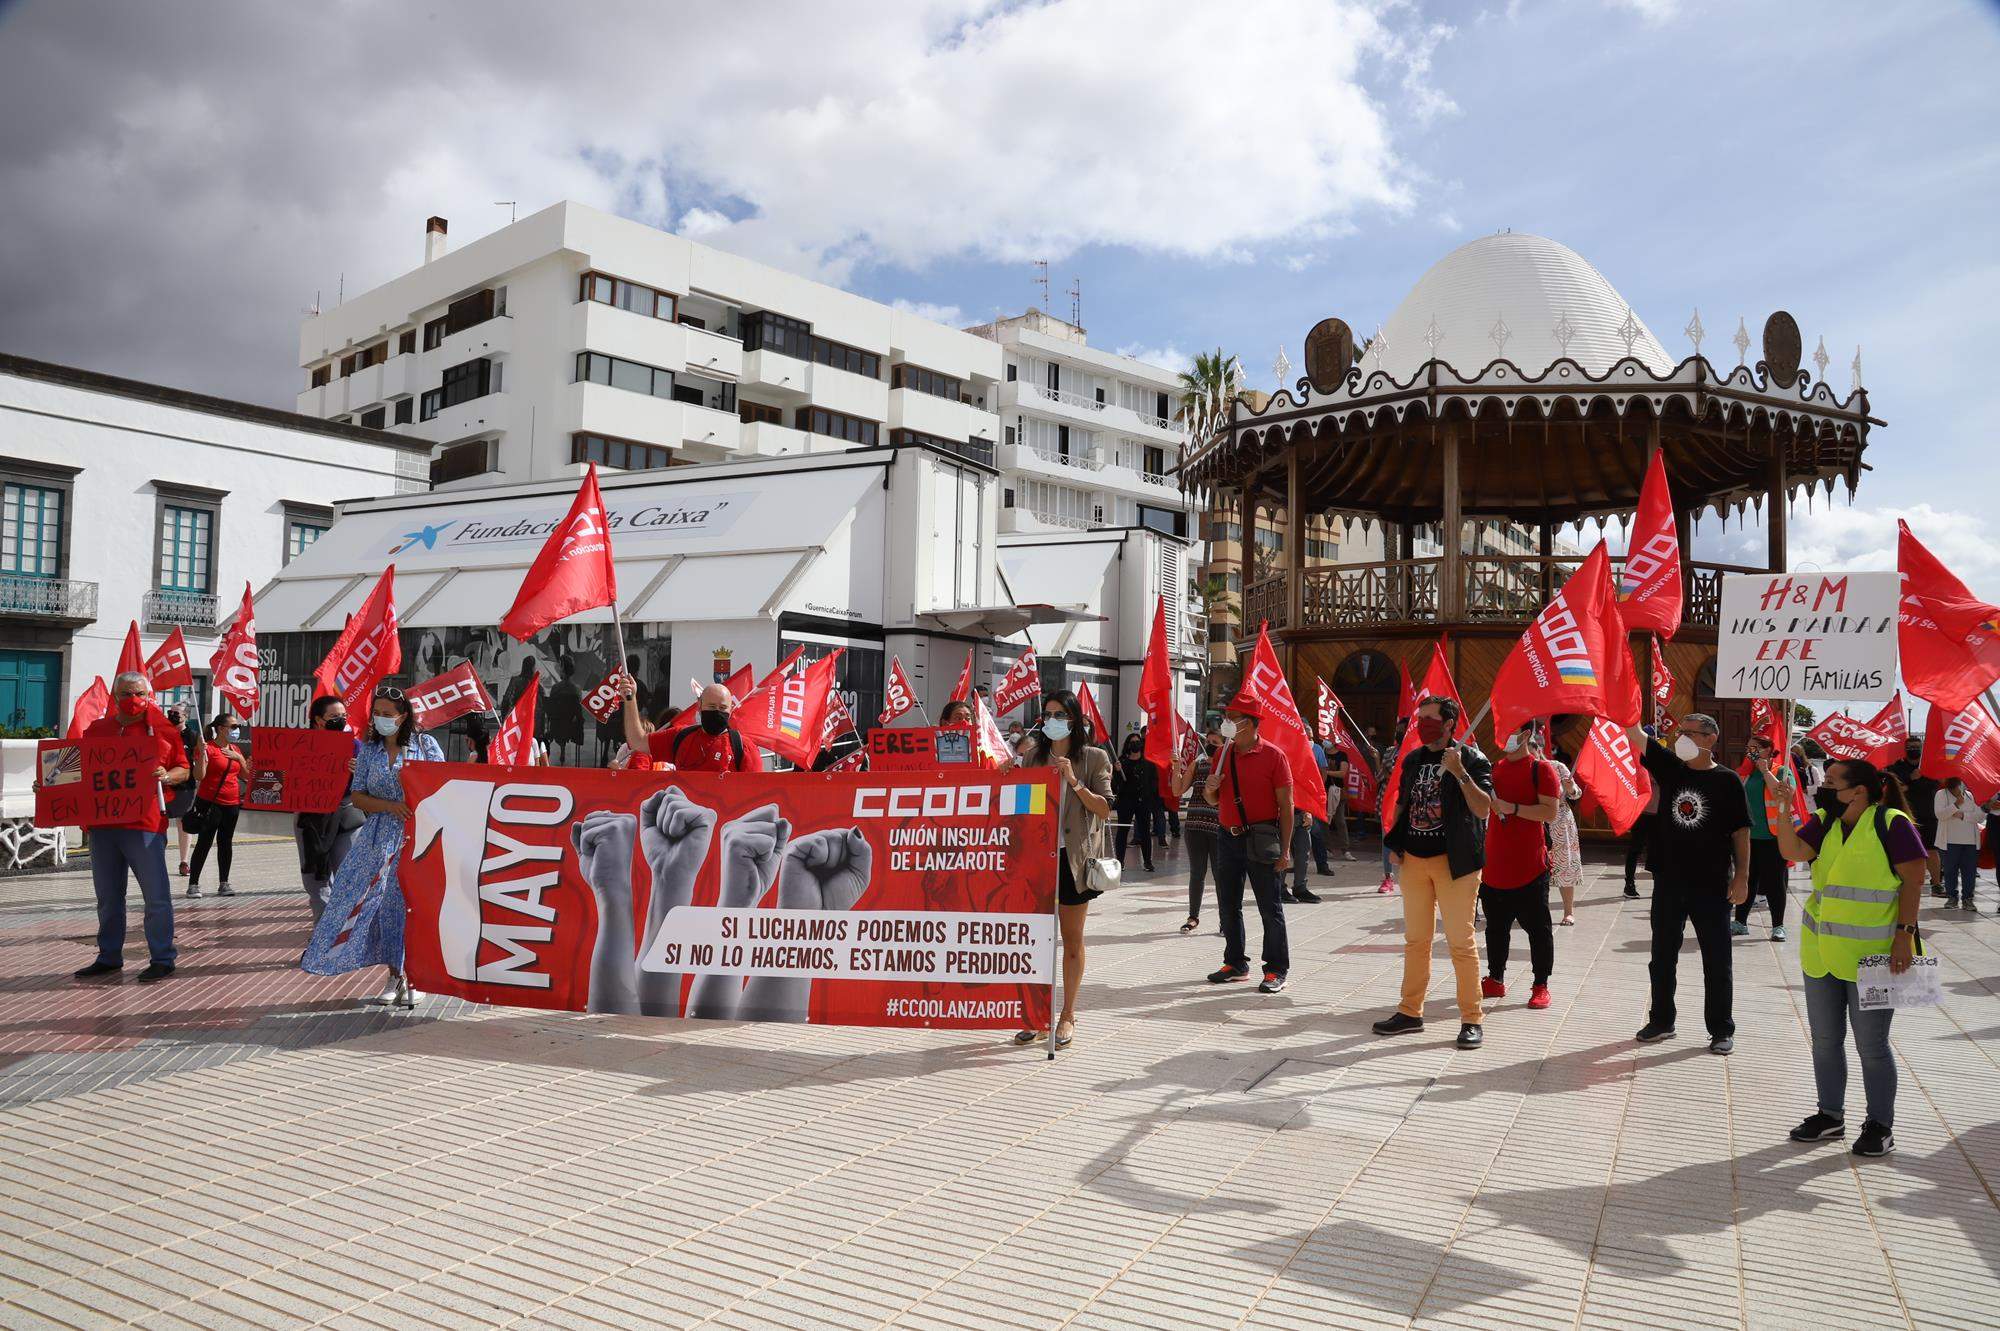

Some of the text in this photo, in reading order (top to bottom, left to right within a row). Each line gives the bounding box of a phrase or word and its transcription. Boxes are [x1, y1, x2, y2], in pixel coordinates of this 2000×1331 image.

[453, 518, 560, 541] Fundaci
[1732, 617, 1776, 634] NOS
[1788, 617, 1871, 633] MANDA
[1756, 638, 1824, 661] ERE
[1527, 650, 1549, 688] servicios
[1732, 665, 1790, 692] 1100
[89, 748, 115, 764] NO
[93, 768, 136, 791] ERE
[52, 797, 79, 821] EN
[853, 785, 992, 818] CCOO
[889, 825, 1010, 847] UNIÓN INSULAR
[890, 850, 1006, 871] DE LANZAROTE
[412, 779, 574, 988] 1 MAYO
[721, 916, 1037, 947] SI LUCHAMOS PODEMOS PERDER,
[665, 943, 1037, 976] SI NO LO HACEMOS, ESTAMOS PERDIDOS.
[886, 999, 1022, 1020] #CCOOLANZAROTE
